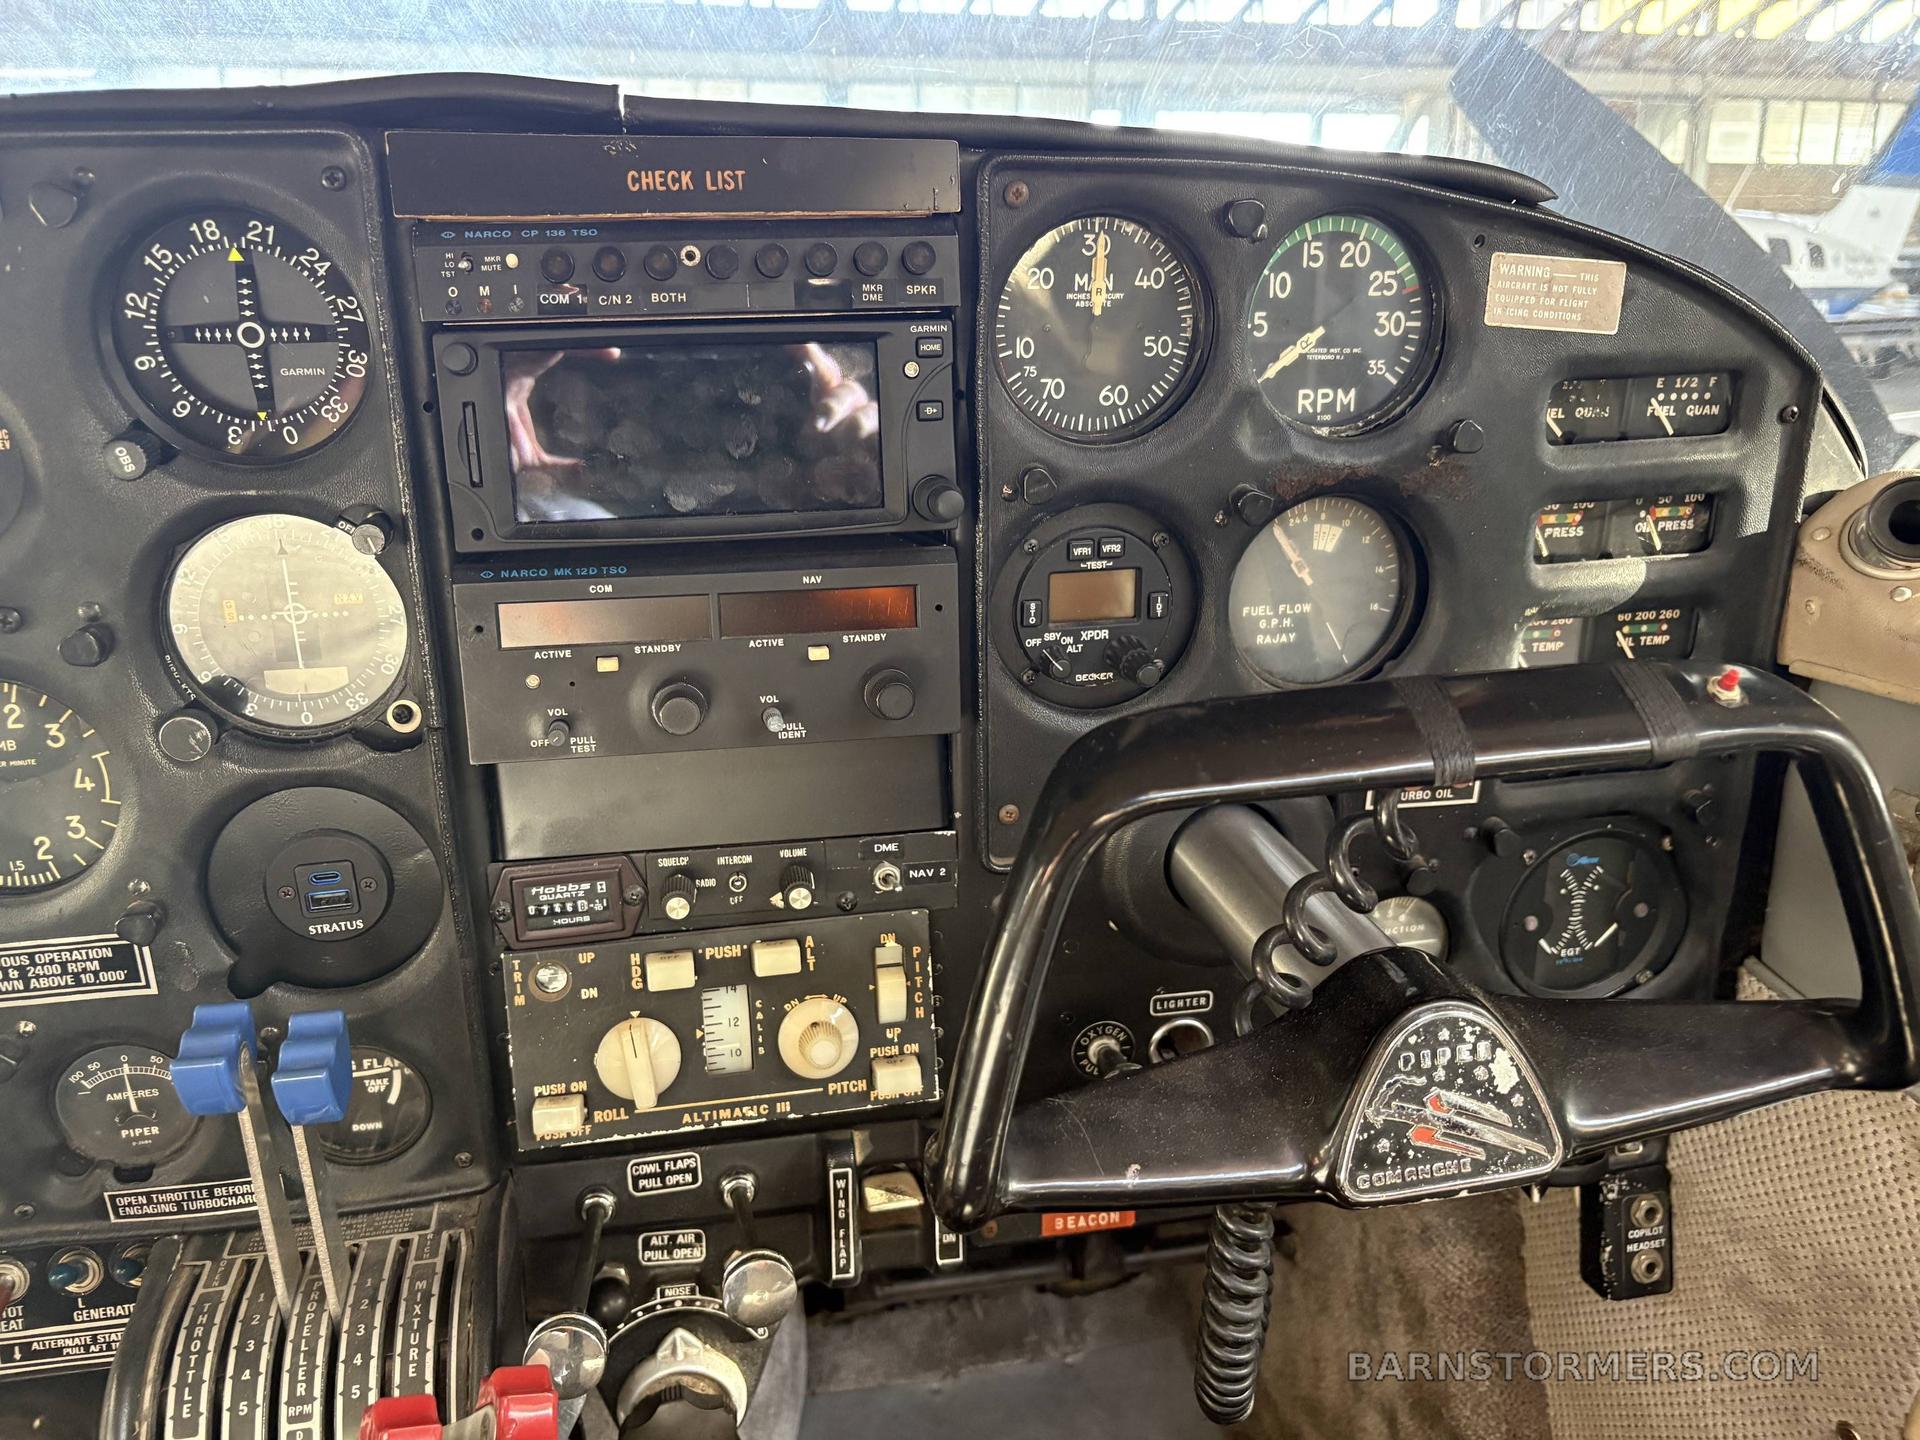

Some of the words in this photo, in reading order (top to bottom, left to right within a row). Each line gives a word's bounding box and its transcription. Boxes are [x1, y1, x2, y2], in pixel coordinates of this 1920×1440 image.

[627, 169, 695, 191] CHECK
[705, 170, 746, 191] LIST
[189, 219, 221, 244] 18
[246, 221, 275, 245] 21
[465, 230, 512, 238] NARCO
[521, 229, 539, 237] CP
[545, 229, 565, 237] 136
[144, 244, 173, 272] 15
[1302, 242, 1324, 268] 15
[1340, 241, 1370, 268] 20
[299, 248, 332, 277] 24
[1027, 268, 1054, 289] 20
[1135, 268, 1165, 289] 40
[1500, 264, 1550, 277] WARNING
[1580, 273, 1599, 281] THIS
[862, 284, 883, 292] MKR
[1269, 271, 1291, 298] 10
[1368, 271, 1398, 296] 25
[1497, 280, 1536, 291] AIRCRAFT
[1540, 283, 1548, 291] IS
[1552, 285, 1568, 293] NOT
[1573, 286, 1597, 295] FULLY
[906, 285, 937, 295] SPKR
[540, 294, 569, 304] COM
[599, 295, 621, 305] C/N
[651, 293, 689, 302] BOTH
[862, 293, 883, 301] DME
[1496, 294, 1535, 304] EQUIPPED
[1540, 297, 1555, 305] FOR
[1559, 299, 1588, 308] FLIGHT
[124, 292, 149, 320] 12
[337, 296, 365, 324] 27
[1506, 307, 1528, 317] ICING
[1533, 310, 1581, 321] CONDITIONS
[910, 325, 948, 333] GARMIN
[1374, 311, 1405, 336] 30
[1016, 337, 1034, 358] 10
[1143, 336, 1172, 357] 50
[280, 367, 326, 377] GARMIN
[1023, 366, 1037, 377] 75
[1367, 360, 1386, 375] 35
[1675, 377, 1698, 388] 1/2
[1040, 379, 1065, 399] 70
[1099, 385, 1128, 406] 60
[1297, 388, 1356, 414] RPM
[1647, 405, 1676, 417] FUEL
[1686, 405, 1719, 416] QUAN
[114, 446, 136, 473] OBS
[1658, 519, 1694, 531] PRESS
[1544, 526, 1584, 538] PRESS
[1073, 547, 1091, 555] VFR1
[1102, 544, 1121, 553] VFR2
[1087, 561, 1107, 569] TEST
[501, 569, 548, 578] NARCO
[554, 568, 572, 576] MK
[576, 567, 597, 575] 12D
[601, 566, 627, 574] TSO
[803, 576, 822, 584] NAV
[589, 585, 612, 593] COM
[1243, 605, 1274, 616] FUEL
[1279, 603, 1312, 615] FLOW
[1634, 611, 1656, 621] 200
[1658, 609, 1680, 619] 260
[1259, 619, 1294, 629] G.P.H.
[842, 633, 886, 643] STANDBY
[1044, 632, 1061, 642] SBY
[1061, 636, 1073, 644] ON
[1081, 629, 1109, 641] XPDR
[1257, 633, 1295, 644] RAJAY
[1640, 635, 1670, 646] TEMP
[634, 644, 681, 654] STANDBY
[749, 638, 784, 648] ACTIVE
[1026, 639, 1042, 647] OFF
[1067, 644, 1083, 653] ALT
[1532, 641, 1564, 652] TEMP
[534, 650, 572, 659] ACTIVE
[1076, 672, 1114, 681] BECKER
[547, 708, 568, 716] VOL
[570, 736, 596, 745] PULL
[778, 730, 807, 739] IDENT
[530, 739, 549, 747] OFF
[571, 744, 596, 753] TEST
[1435, 789, 1453, 799] OIL
[780, 847, 807, 858] VOLUME
[874, 843, 899, 852] DME
[718, 855, 752, 865] INTERCOM
[909, 869, 934, 879] NAV
[530, 882, 591, 895] Hobbs
[539, 891, 585, 901] QUARTZ
[553, 916, 591, 925] HOURS
[309, 920, 364, 934] STRATUS
[35, 948, 113, 964] OPERATION
[705, 944, 741, 960] PUSH
[805, 936, 815, 971] ALT
[579, 953, 595, 964] UP
[27, 965, 61, 976] 2400
[68, 961, 100, 973] RPM
[631, 954, 643, 990] HDG
[30, 975, 76, 989] ABOVE
[512, 960, 525, 1006] TRIM
[912, 947, 924, 1018] PITCH
[581, 988, 598, 999] DN
[1157, 997, 1206, 1010] LIGHTER
[1080, 1026, 1127, 1045] OXYGEN
[870, 1045, 899, 1058] PUSH
[904, 1043, 919, 1053] ON
[364, 1078, 390, 1086] TAKE
[828, 1080, 867, 1095] PITCH
[534, 1083, 566, 1096] PUSH
[570, 1081, 587, 1092] ON
[106, 1089, 160, 1101] AMPERES
[777, 1101, 790, 1112] III
[594, 1108, 629, 1123] ROLL
[121, 1126, 160, 1138] PIPER
[352, 1122, 382, 1131] DOWN
[632, 1163, 662, 1176] COWL
[665, 1158, 696, 1171] FLAPS
[1356, 1158, 1471, 1189] COMANCHE
[638, 1177, 662, 1190] PULL
[666, 1174, 692, 1186] OPEN
[116, 1195, 147, 1206] OPEN
[151, 1189, 209, 1203] THROTTLE
[836, 1178, 846, 1218] WING
[119, 1203, 177, 1216] ENGAGING
[1054, 1212, 1120, 1230] BEACON
[1628, 1225, 1664, 1239] COPILOT
[650, 1234, 673, 1246] ALT.
[677, 1234, 695, 1244] AIR
[1627, 1238, 1666, 1252] HEADSET
[644, 1250, 670, 1261] PULL
[674, 1247, 700, 1259] OPEN
[664, 1286, 691, 1296] NOSE
[408, 1280, 427, 1378] MIXTURE
[31, 1336, 92, 1351] ALTERNATE
[297, 1281, 323, 1397] PROPELLER
[63, 1346, 85, 1355] PULL
[90, 1344, 107, 1352] AFT
[182, 1303, 210, 1419] THROTTLE
[288, 1404, 313, 1416] RPM
